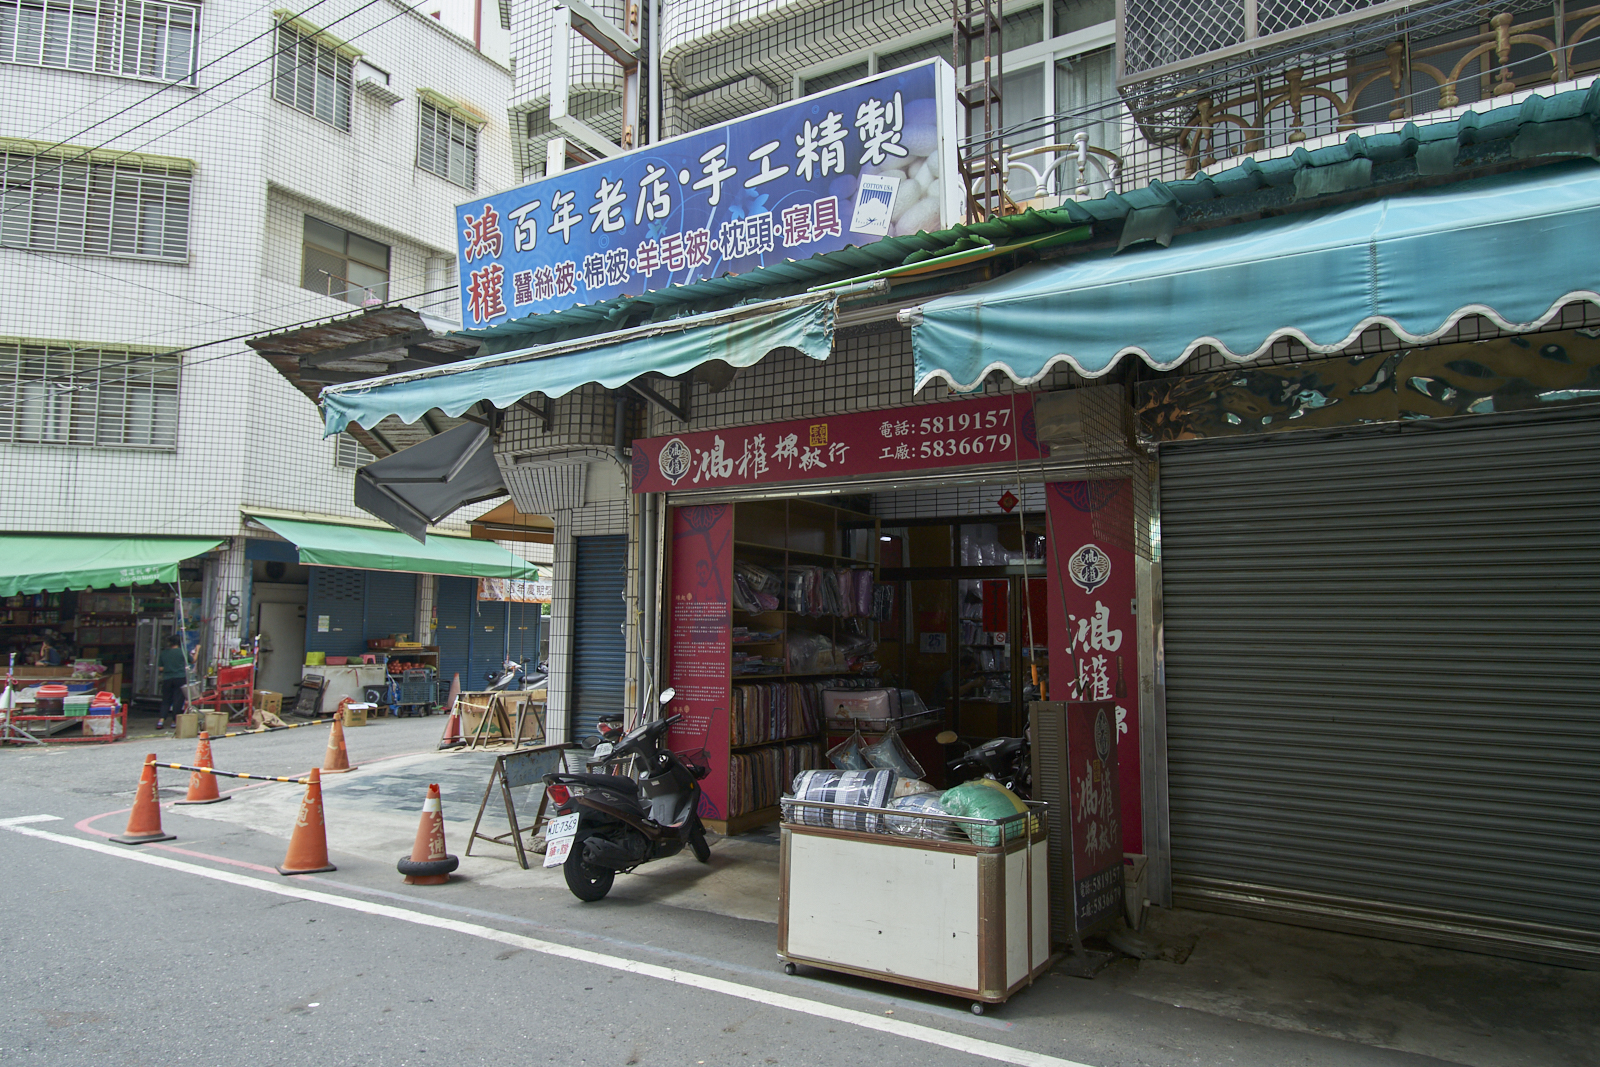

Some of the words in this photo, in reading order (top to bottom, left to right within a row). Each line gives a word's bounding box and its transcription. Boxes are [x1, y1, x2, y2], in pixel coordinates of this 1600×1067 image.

[862, 182, 883, 190] COTTON
[464, 203, 506, 324] 鴻權
[692, 432, 850, 484] 鴻權棉被行
[928, 633, 941, 647] 25
[1076, 758, 1114, 823] 鴻權
